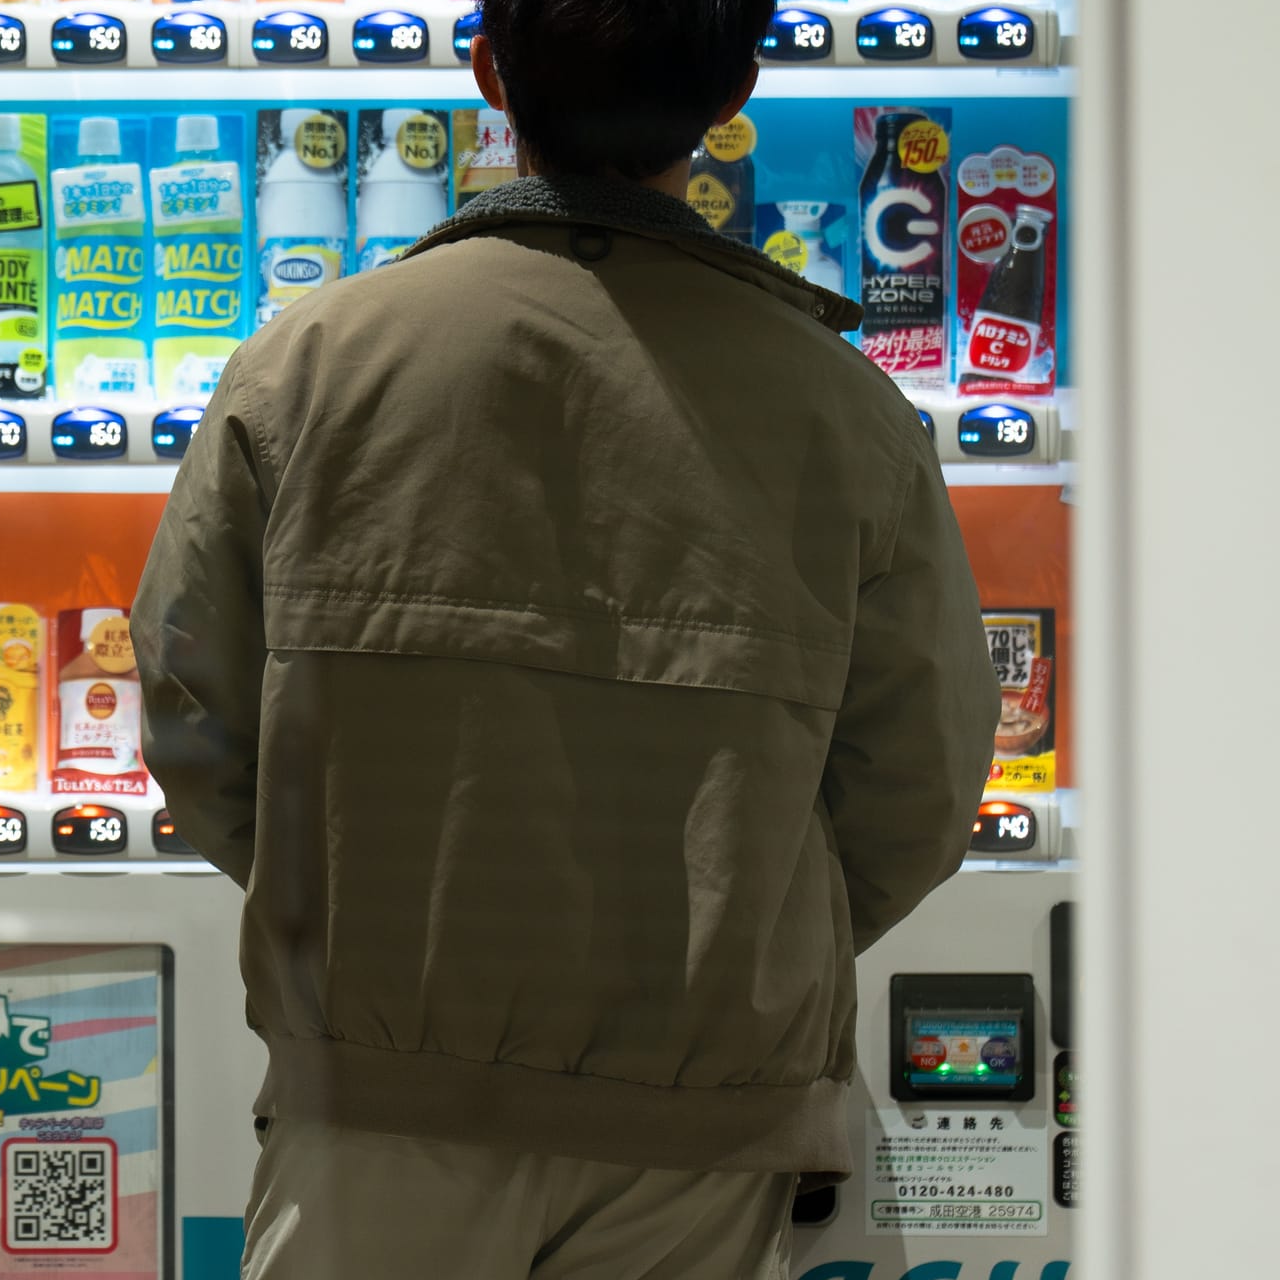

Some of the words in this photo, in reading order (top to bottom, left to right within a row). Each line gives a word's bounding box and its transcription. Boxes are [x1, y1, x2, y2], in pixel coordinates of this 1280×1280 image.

[793, 23, 825, 48] 120
[894, 22, 926, 47] 120
[995, 22, 1027, 47] 120
[302, 143, 338, 160] No.1
[404, 143, 440, 160] No.1
[688, 199, 731, 212] ORGIA
[862, 274, 941, 289] HYPER
[58, 292, 143, 319] MATCH
[157, 291, 241, 317] MATCH
[876, 305, 924, 313] ENERGY
[862, 327, 943, 357] フタ付最強
[975, 323, 1029, 347] オロナミン
[990, 340, 1004, 354] C
[979, 353, 1011, 368] ドリンク
[997, 419, 1028, 444] 130
[1011, 632, 1028, 683] しじみ
[89, 818, 121, 841] 150
[998, 814, 1029, 839] 140
[921, 1057, 937, 1066] NG
[989, 1057, 1006, 1067] OK
[911, 1116, 1005, 1131] ご連絡先
[898, 1185, 1014, 1198] 0120-424-480
[929, 1205, 982, 1218] 成田空港
[988, 1205, 1035, 1217] 25974
